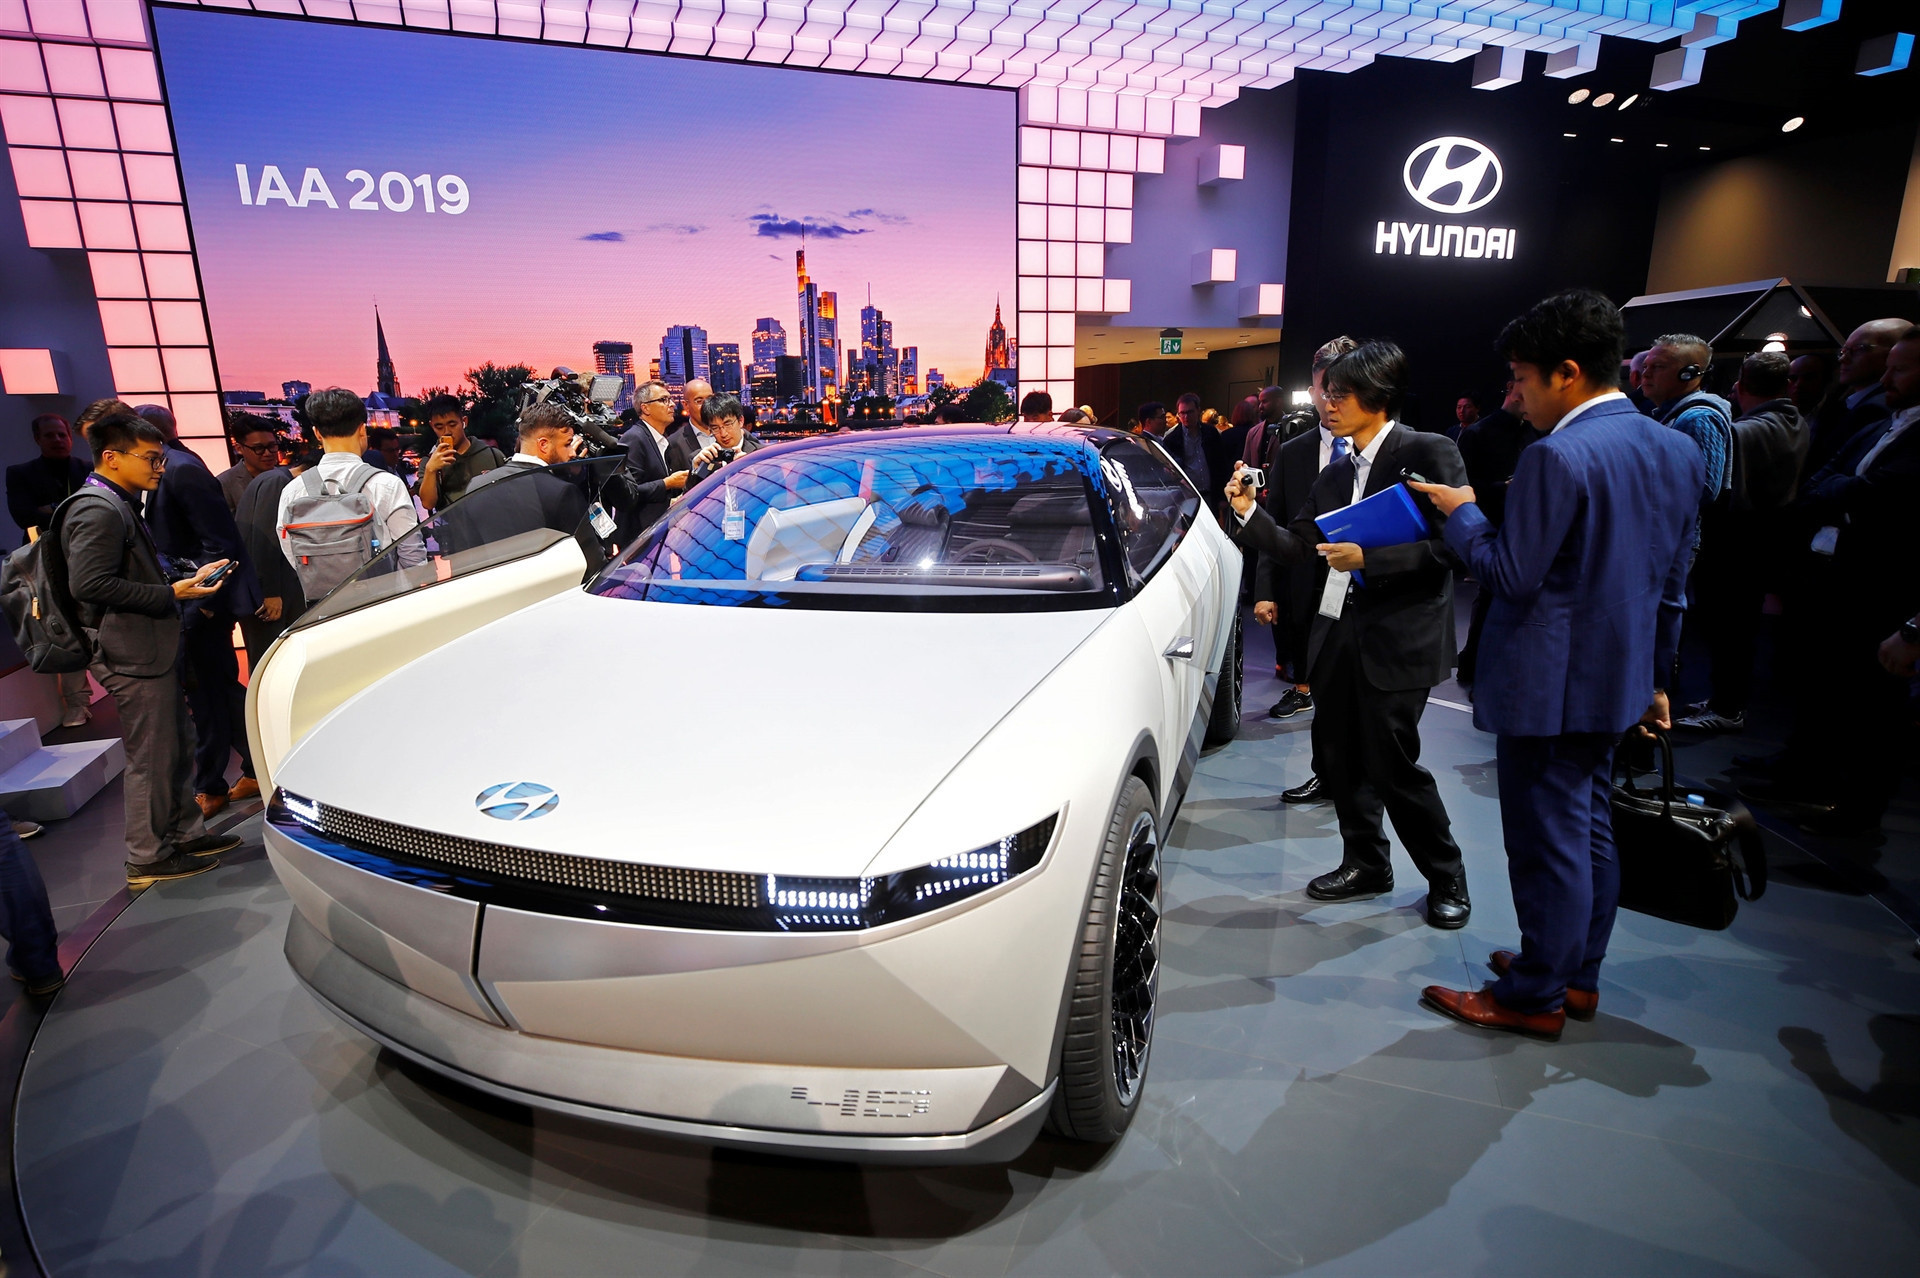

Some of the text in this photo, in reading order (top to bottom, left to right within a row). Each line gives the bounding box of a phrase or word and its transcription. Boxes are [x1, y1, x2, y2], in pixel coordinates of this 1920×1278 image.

[235, 163, 470, 215] IAA 2019
[1375, 221, 1516, 260] HYUNDAI
